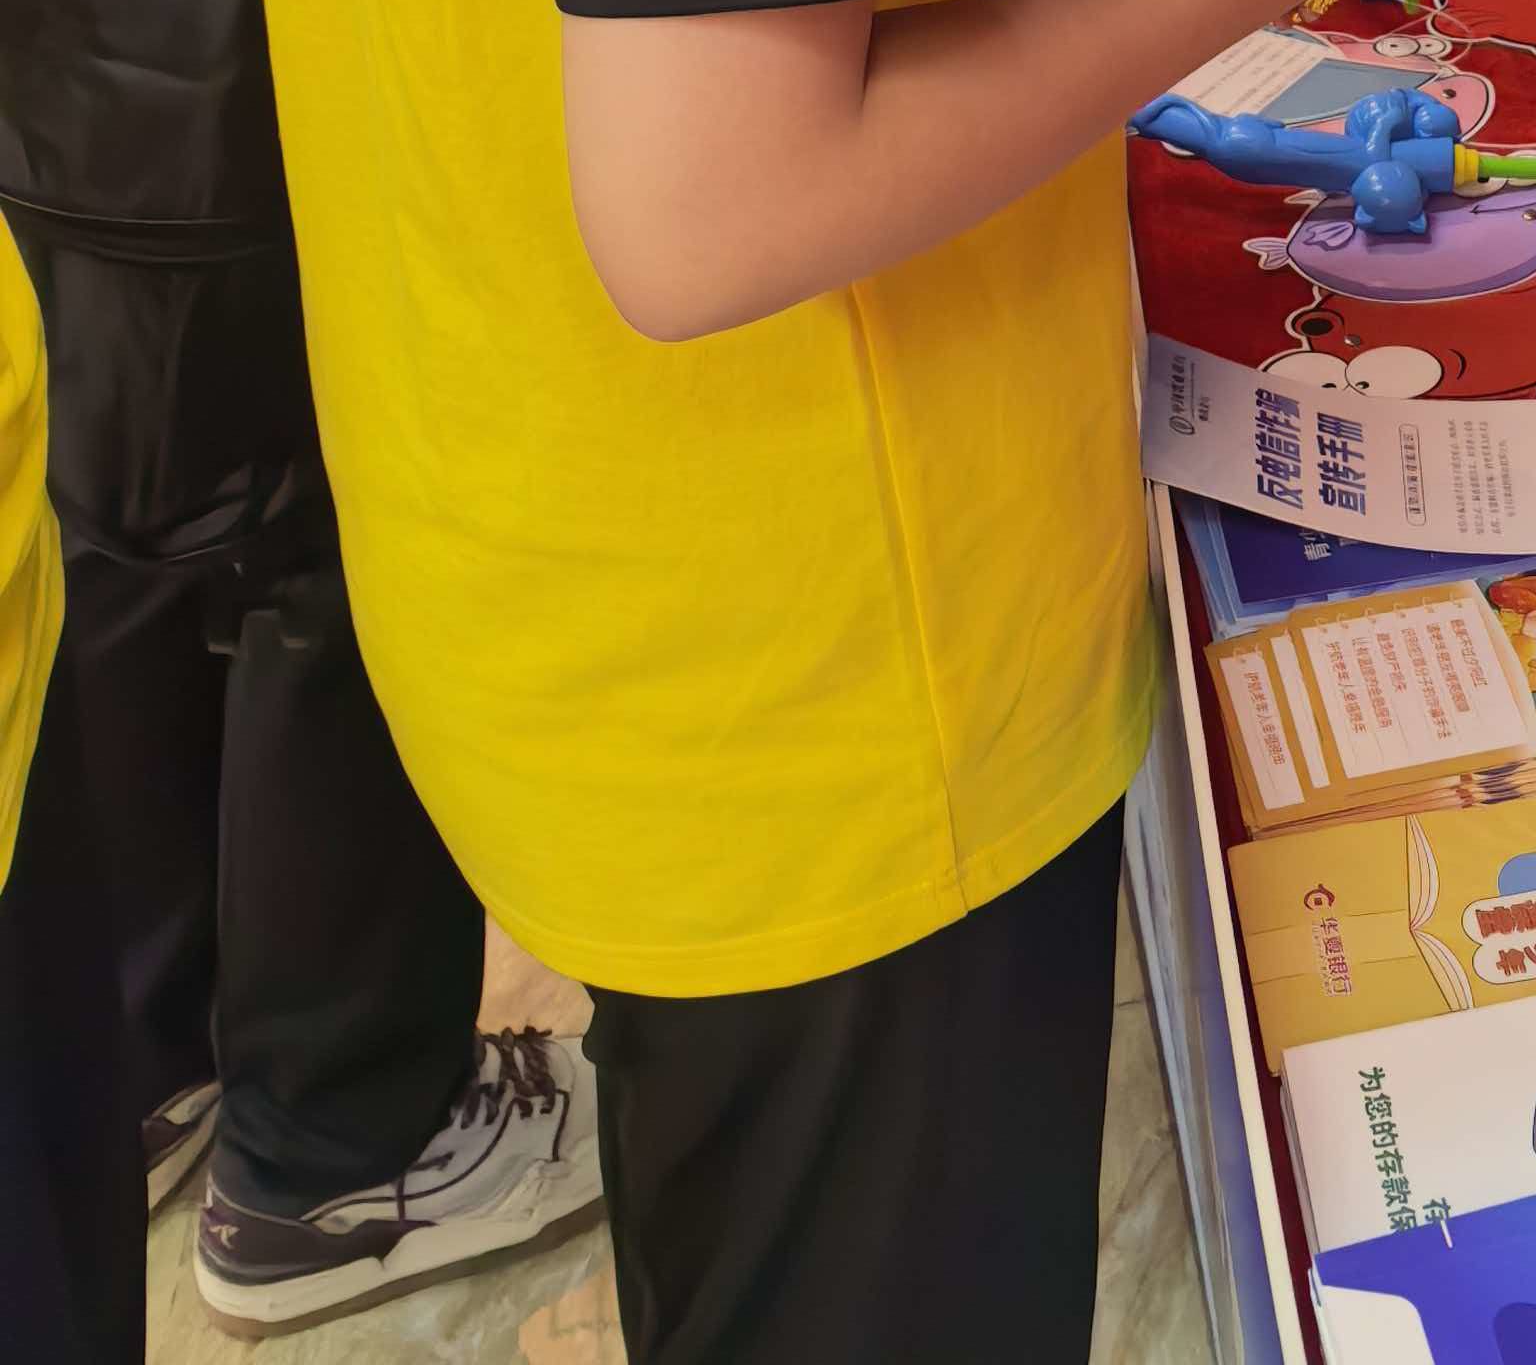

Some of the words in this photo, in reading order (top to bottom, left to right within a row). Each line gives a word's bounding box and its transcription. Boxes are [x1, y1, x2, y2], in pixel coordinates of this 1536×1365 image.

[1255, 388, 1304, 510] 反电信诈骗
[1316, 412, 1367, 517] 宣传手册
[1319, 916, 1352, 995] 华夏银行
[1357, 1066, 1418, 1233] 为您的存款保
